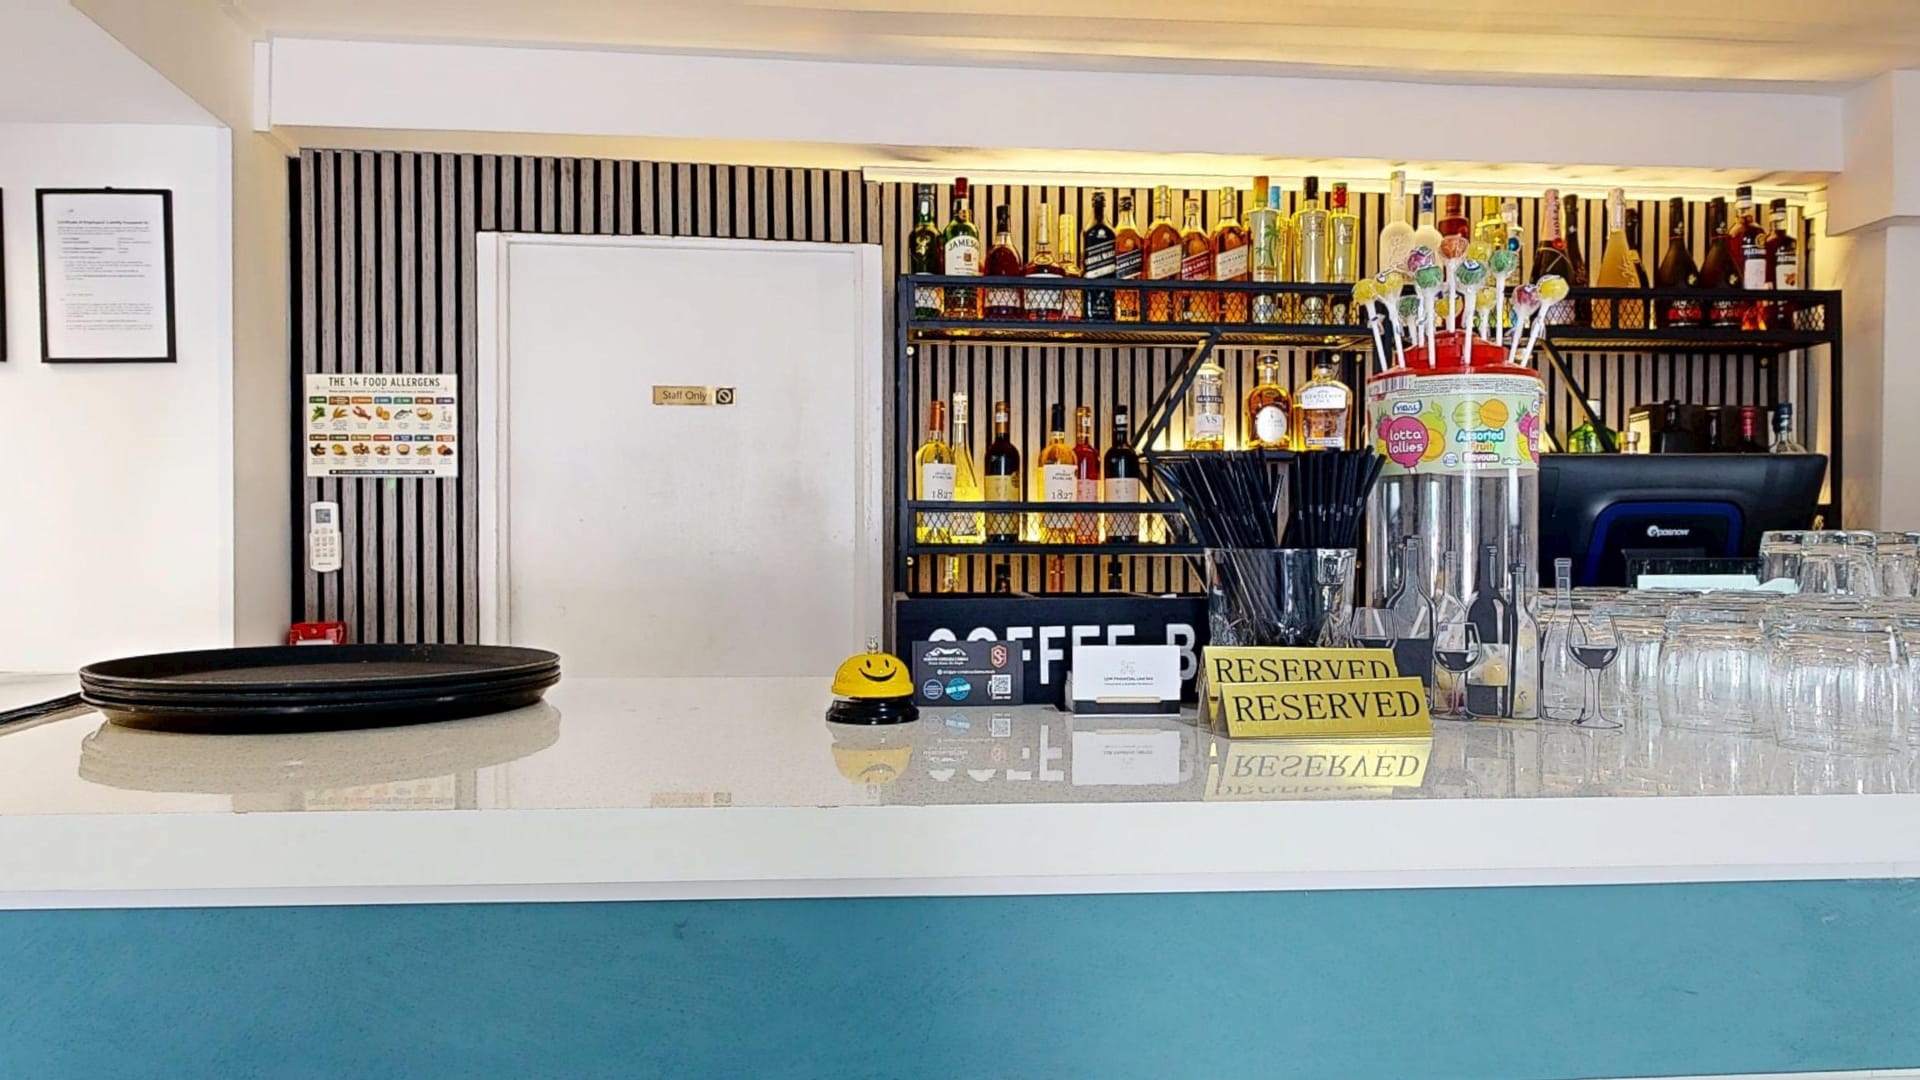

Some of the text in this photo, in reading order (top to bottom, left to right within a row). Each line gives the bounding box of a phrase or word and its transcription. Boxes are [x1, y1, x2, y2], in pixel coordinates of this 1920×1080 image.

[329, 377, 441, 387] THE 14 FOOD ALLERGENS
[662, 390, 707, 402] Staff Only
[1390, 429, 1422, 441] lotta
[1457, 429, 1504, 441] Assorted
[1388, 441, 1424, 455] lollies
[931, 488, 953, 499] 1827
[1051, 488, 1073, 499] 1827
[1213, 658, 1391, 683] RESERVED
[1232, 690, 1420, 722] RESERVED
